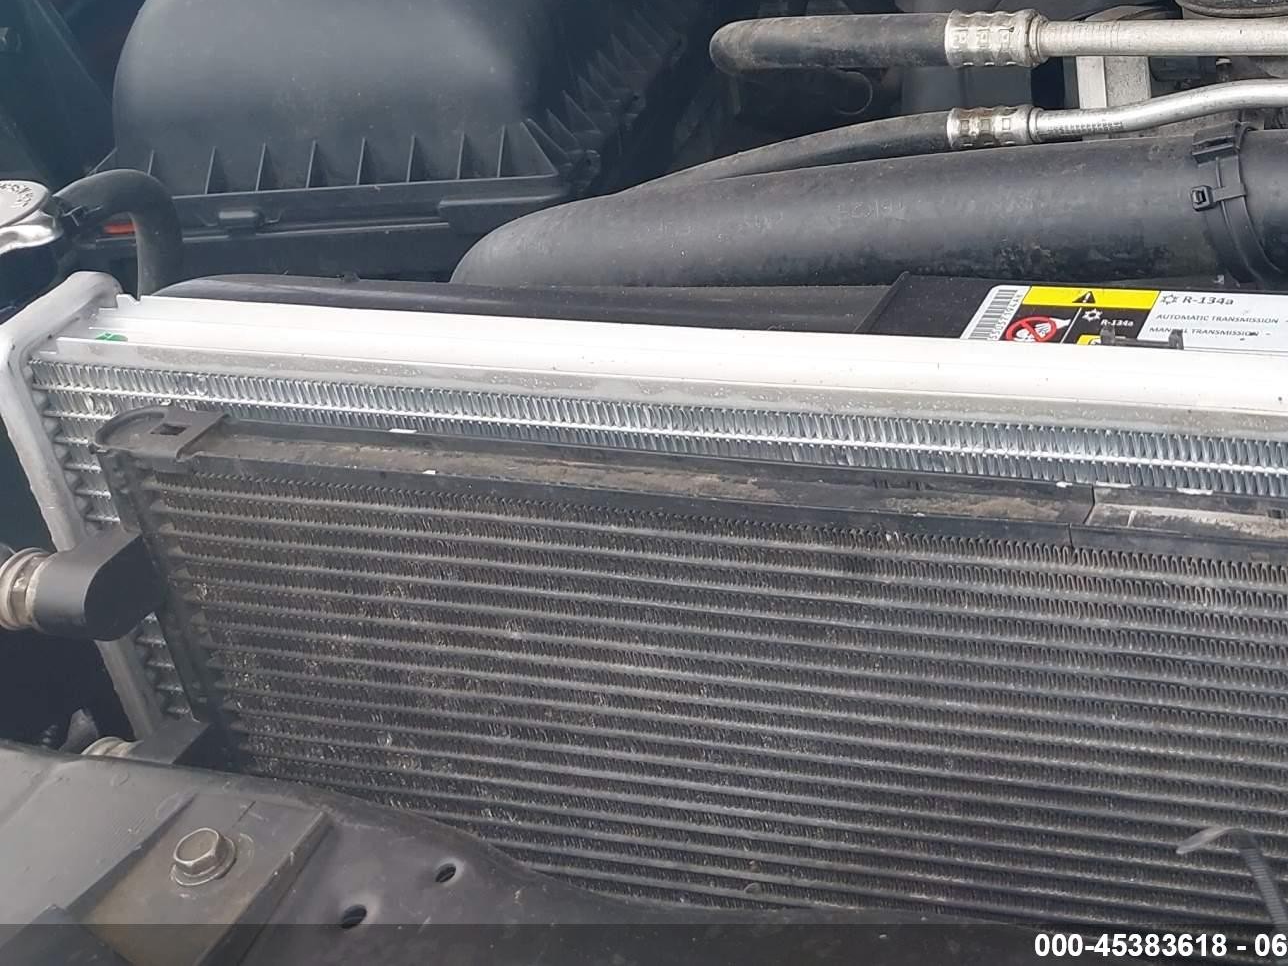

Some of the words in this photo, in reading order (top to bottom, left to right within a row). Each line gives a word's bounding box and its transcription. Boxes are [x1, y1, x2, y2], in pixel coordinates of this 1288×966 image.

[1182, 295, 1234, 306] R-134a
[1101, 318, 1134, 327] R-134a
[1156, 313, 1210, 322] AUTOMATIC
[1211, 315, 1279, 324] TRANSMISSION
